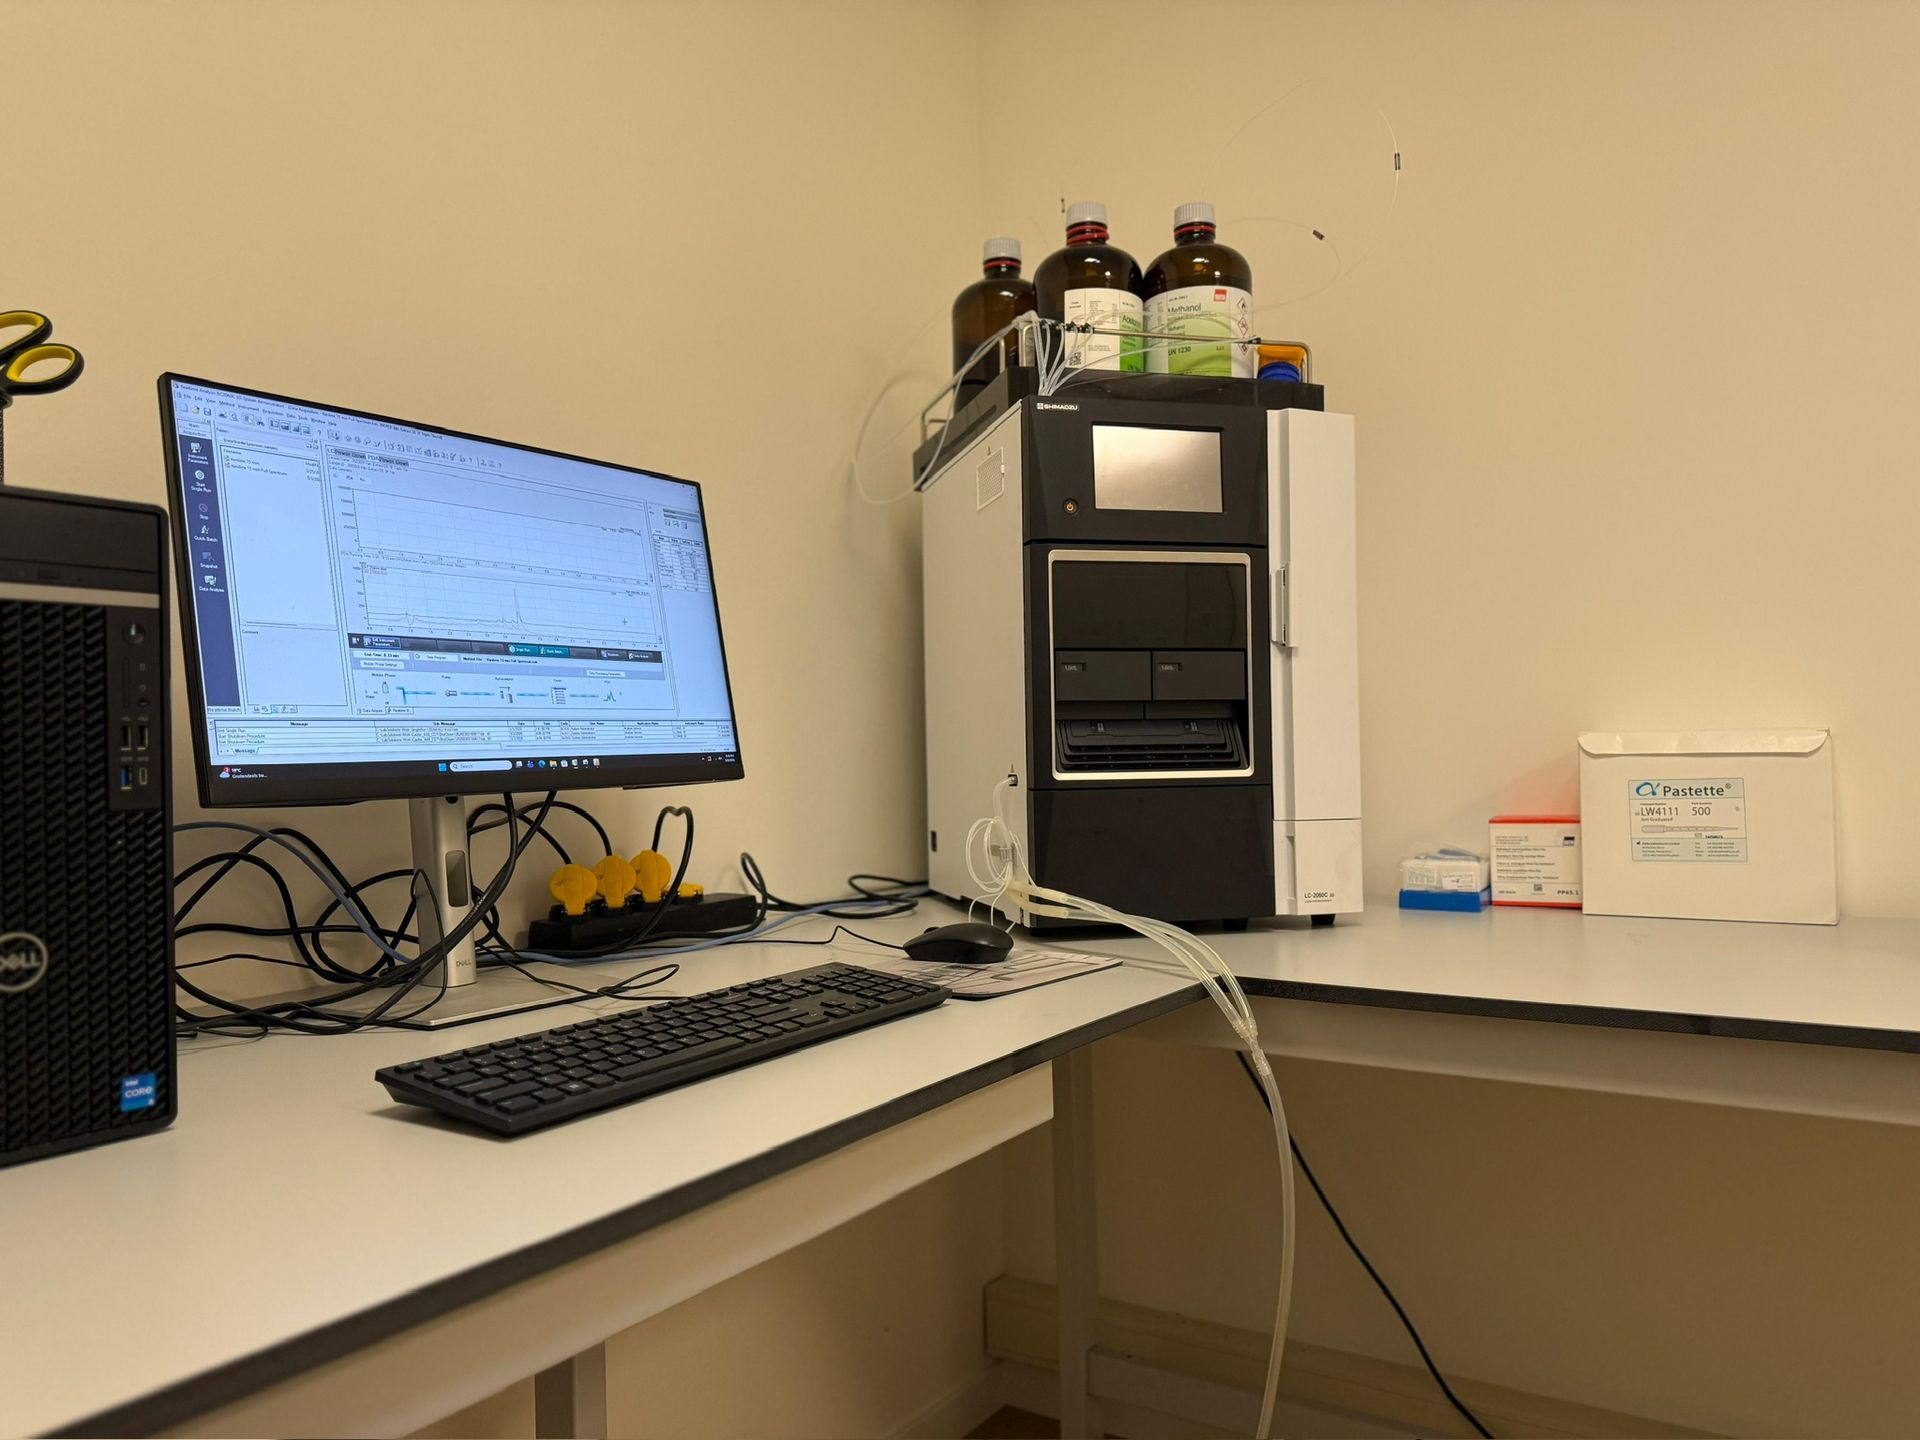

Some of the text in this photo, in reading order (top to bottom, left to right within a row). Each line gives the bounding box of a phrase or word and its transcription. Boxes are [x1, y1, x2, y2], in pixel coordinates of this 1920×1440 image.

[1168, 303, 1202, 312] Methanol
[1178, 346, 1192, 354] 1230
[1640, 806, 1679, 816] LW4111
[1692, 806, 1711, 816] 500
[456, 960, 472, 968] DELL
